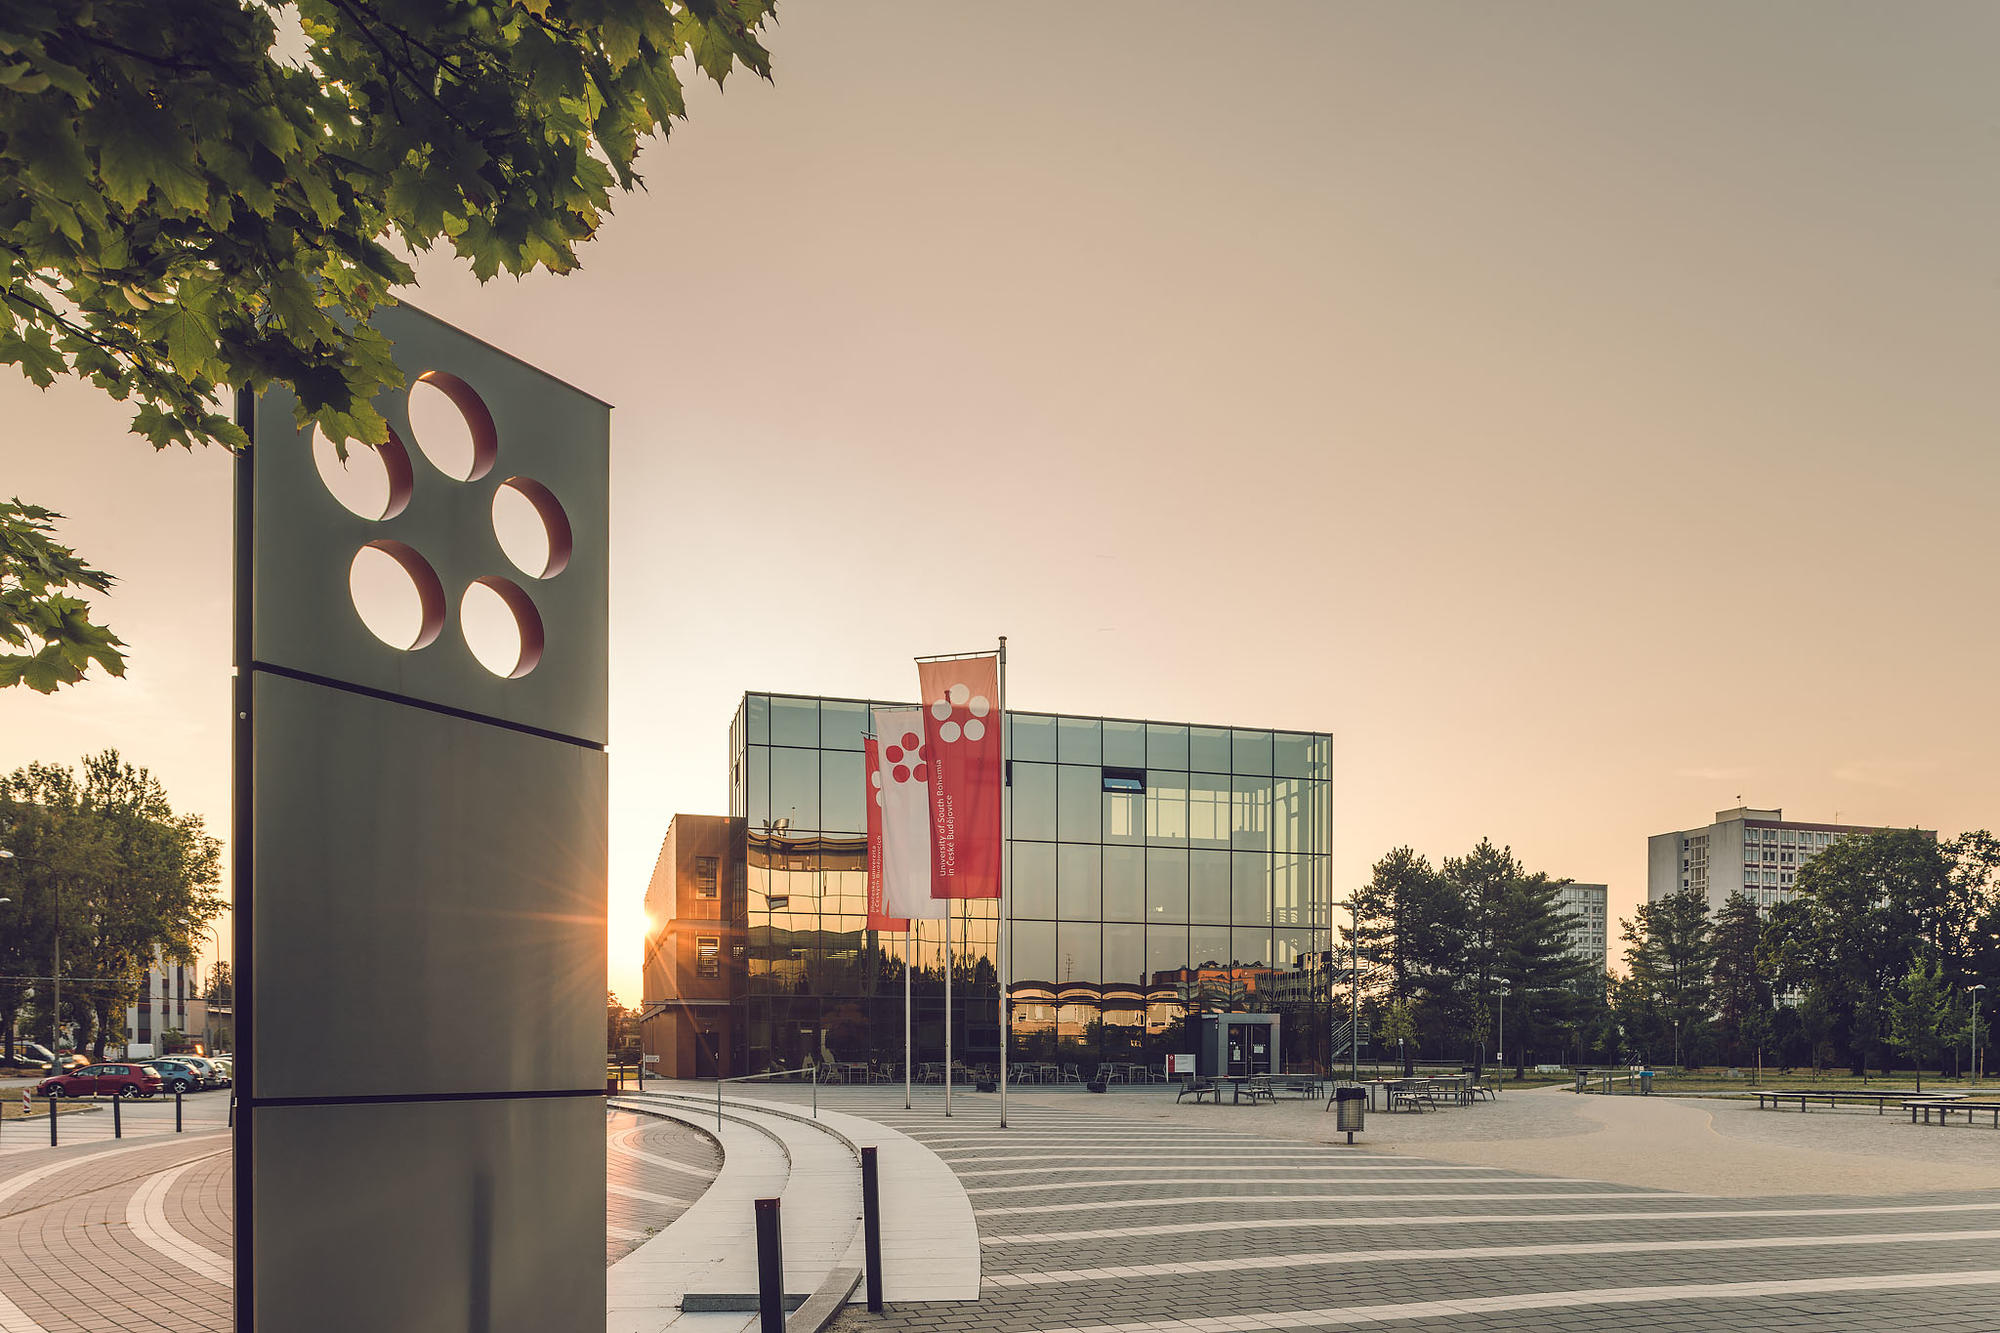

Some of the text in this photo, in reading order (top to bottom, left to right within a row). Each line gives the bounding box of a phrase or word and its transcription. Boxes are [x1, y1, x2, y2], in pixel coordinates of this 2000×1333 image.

[936, 759, 946, 876] University of South Bohemia
[946, 794, 955, 876] in České Budějovice
